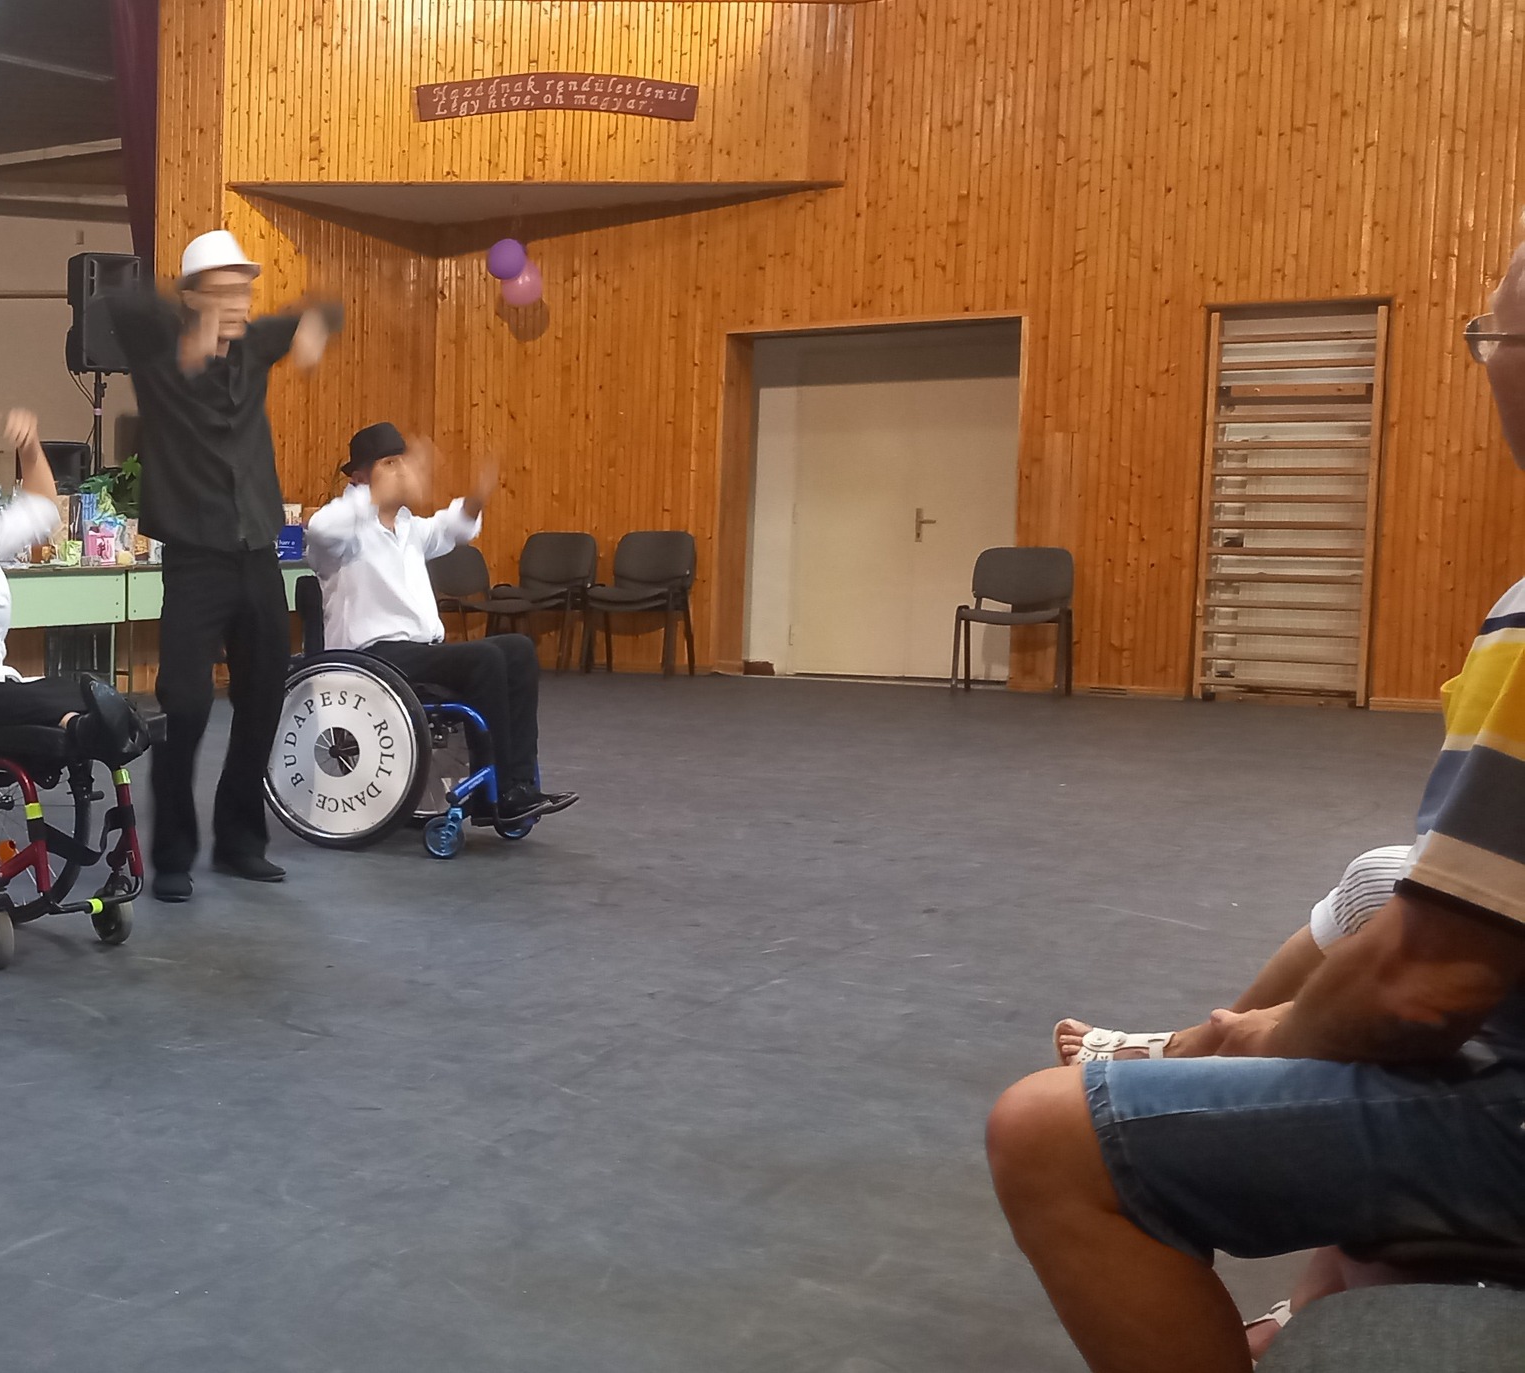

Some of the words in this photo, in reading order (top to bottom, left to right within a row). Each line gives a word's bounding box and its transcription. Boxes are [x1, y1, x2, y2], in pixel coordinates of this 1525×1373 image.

[432, 75, 540, 102] Hazádnak
[373, 719, 395, 778] ROLL
[316, 781, 382, 813] DANCE
